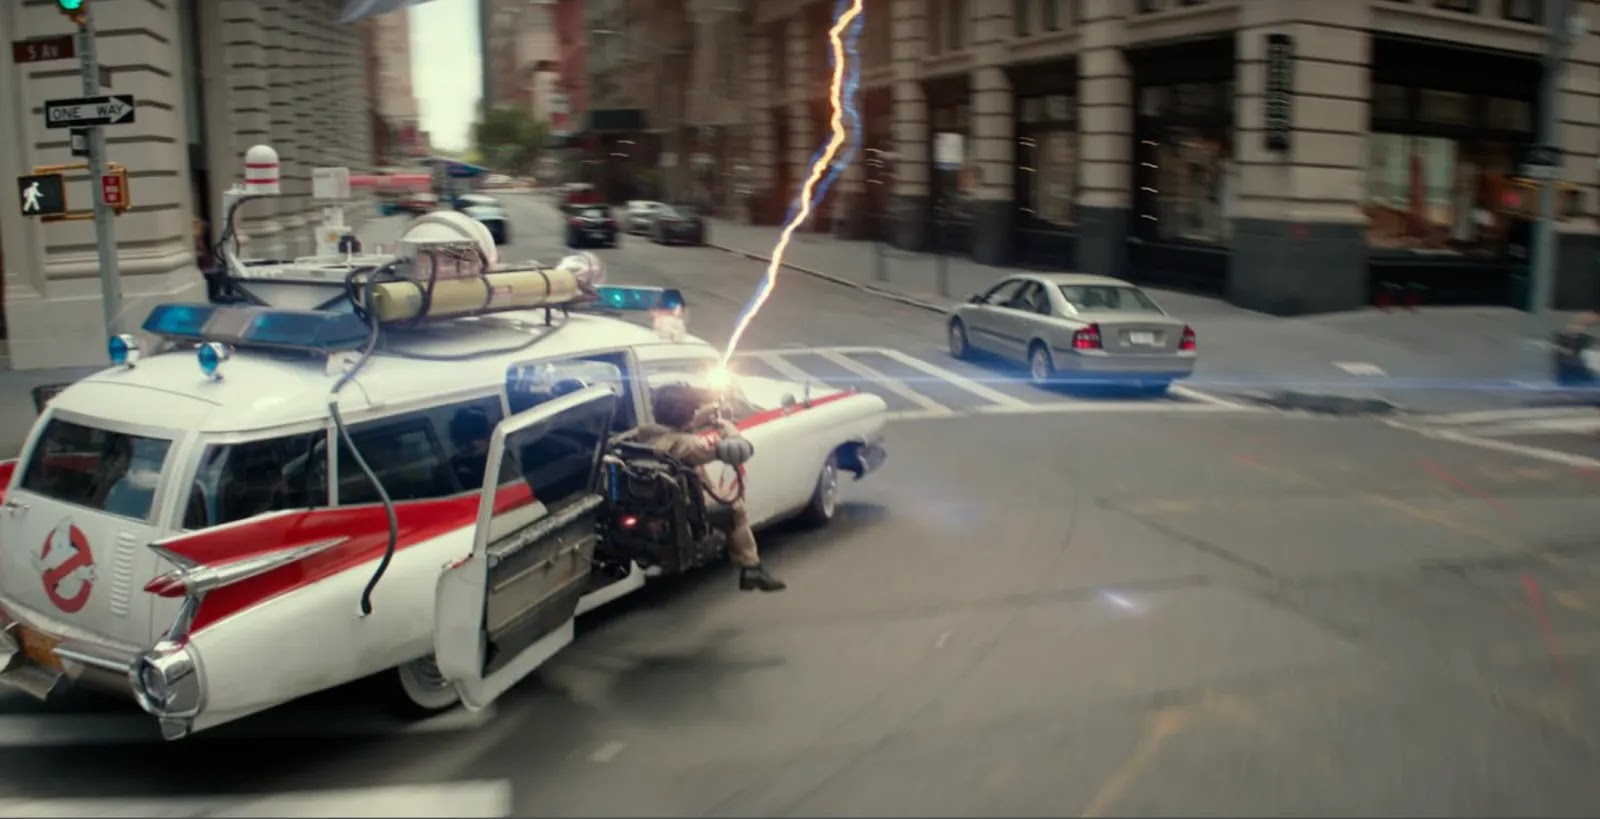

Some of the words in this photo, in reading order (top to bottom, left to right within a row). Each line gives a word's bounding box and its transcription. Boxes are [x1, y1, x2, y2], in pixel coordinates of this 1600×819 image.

[28, 45, 36, 60] 5
[53, 107, 81, 119] ONE
[97, 104, 123, 116] WAY
